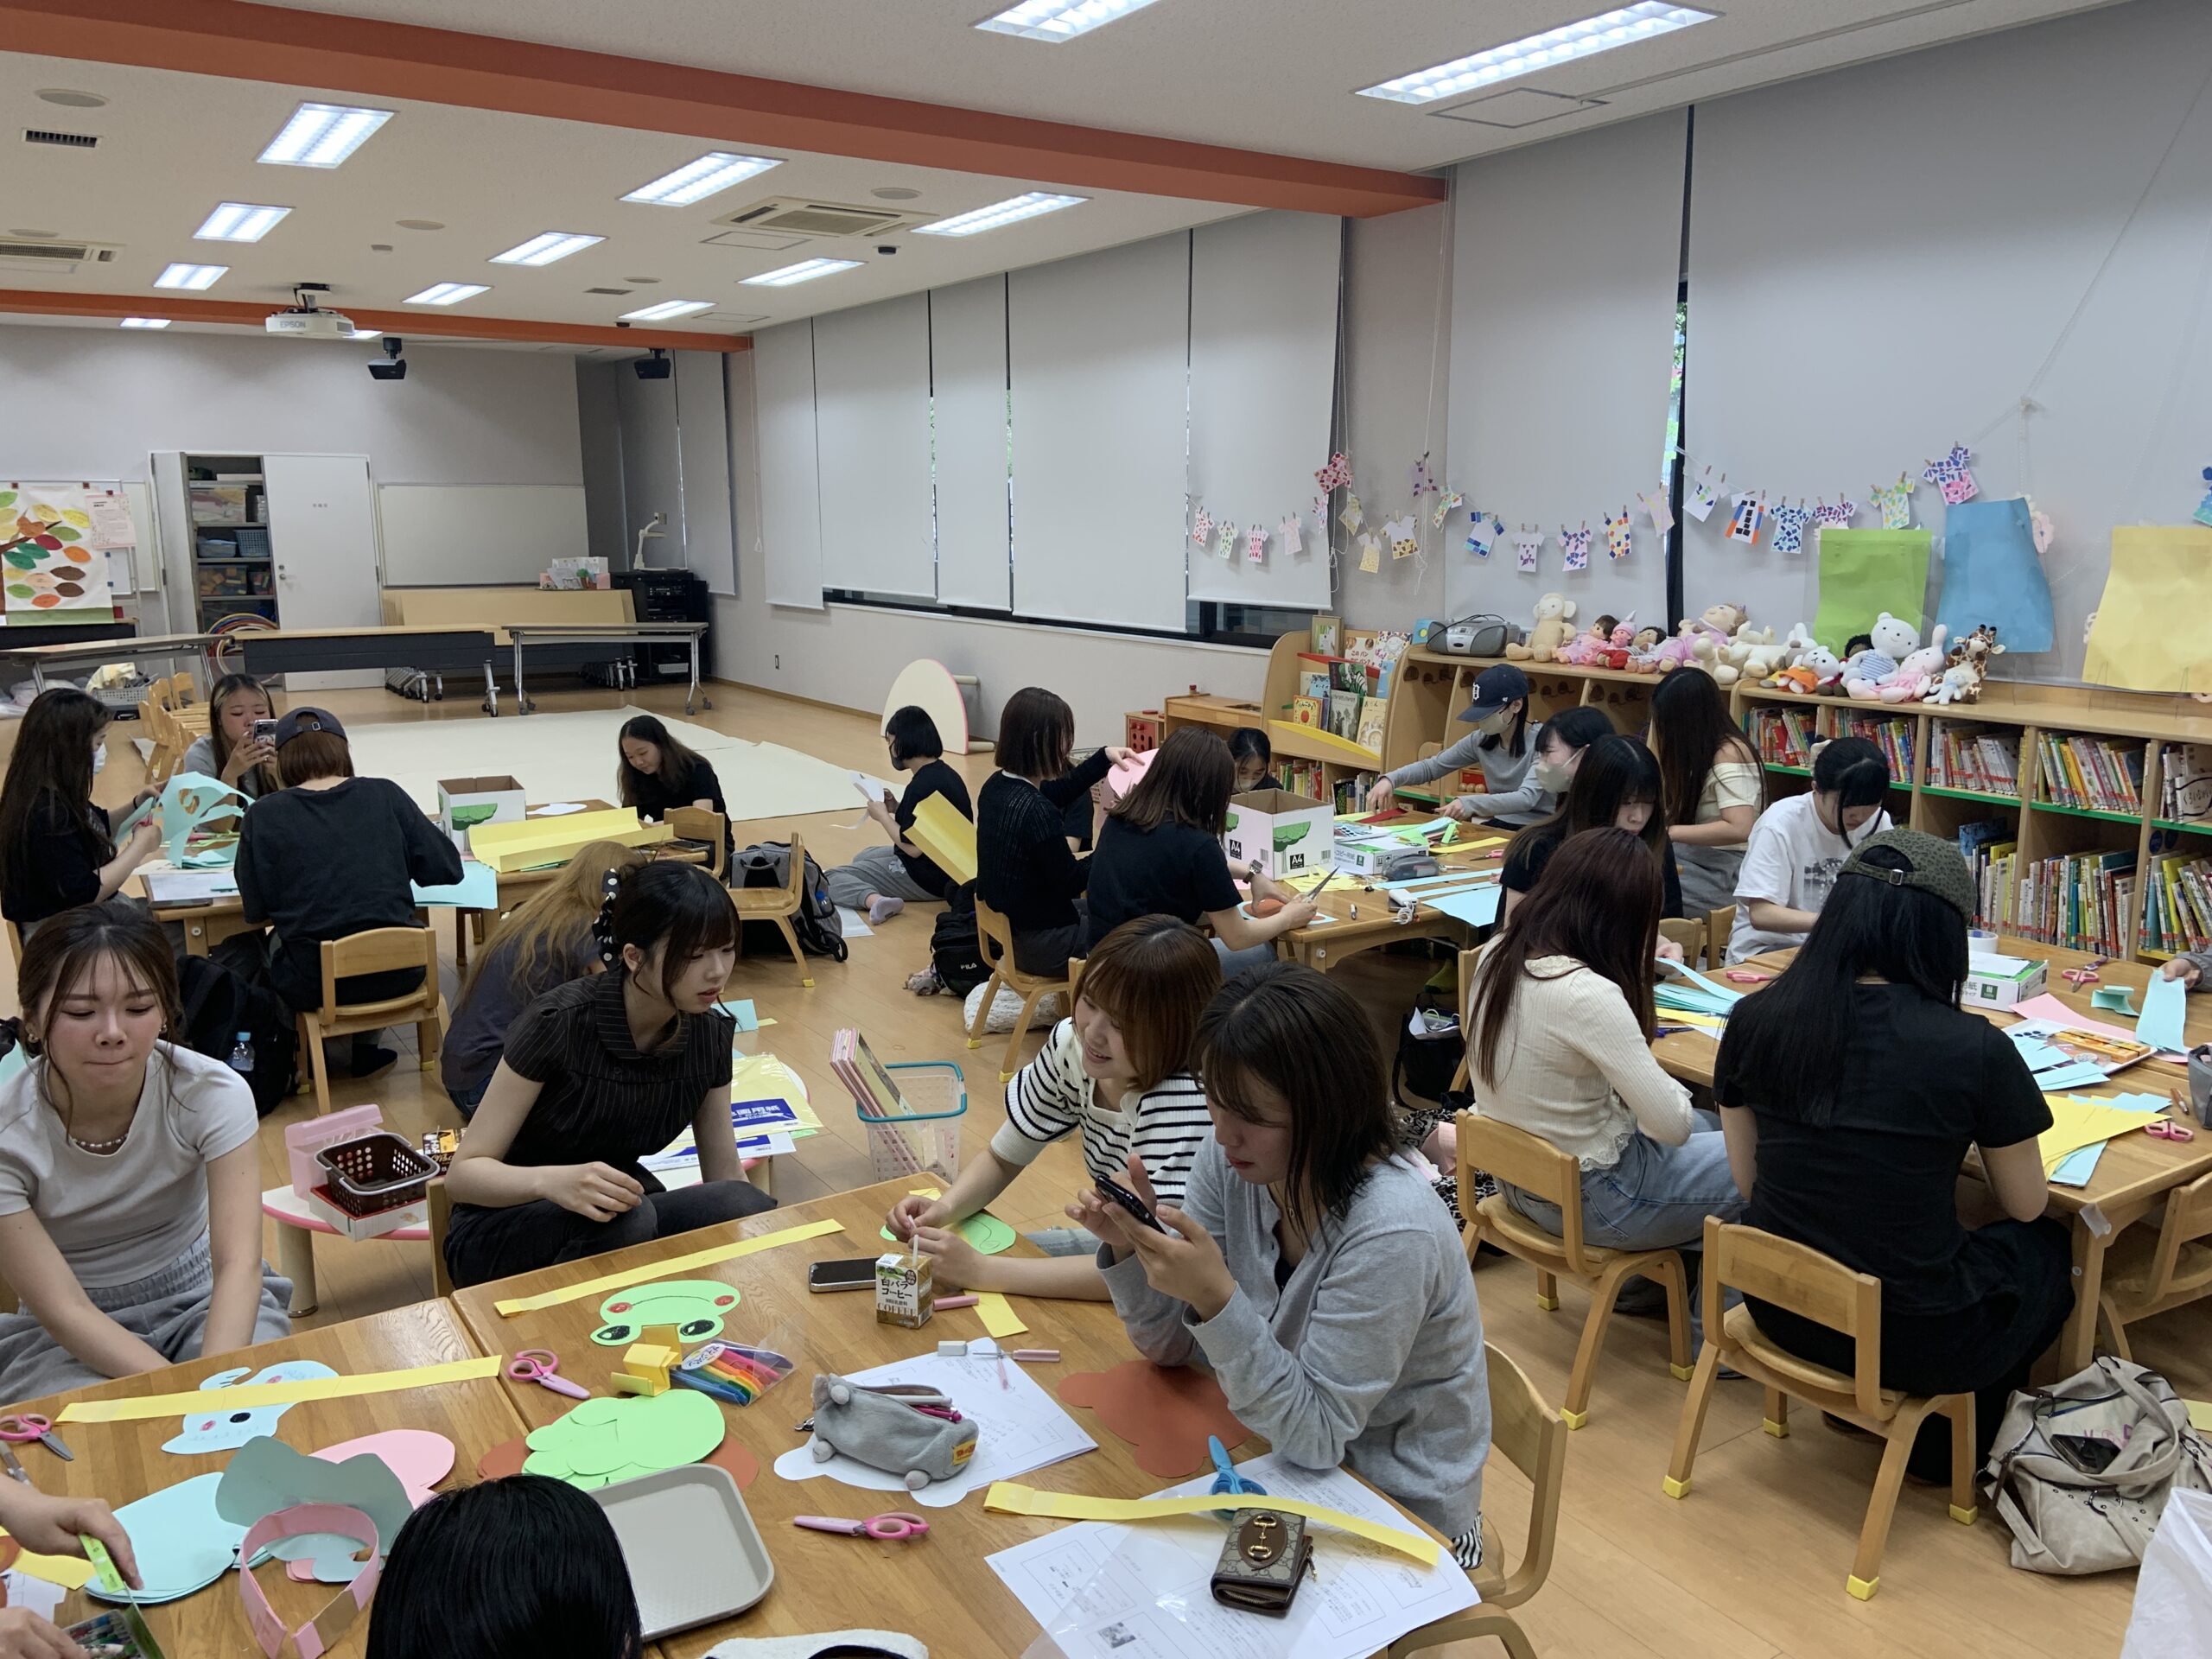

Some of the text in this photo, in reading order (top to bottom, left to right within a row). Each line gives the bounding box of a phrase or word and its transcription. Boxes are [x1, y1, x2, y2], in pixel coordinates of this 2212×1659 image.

[280, 320, 306, 328] EPSON
[1230, 841, 1241, 853] A4
[1291, 855, 1303, 864] A4
[881, 1277, 908, 1290] 白バラ
[881, 1287, 912, 1299] コーヒー
